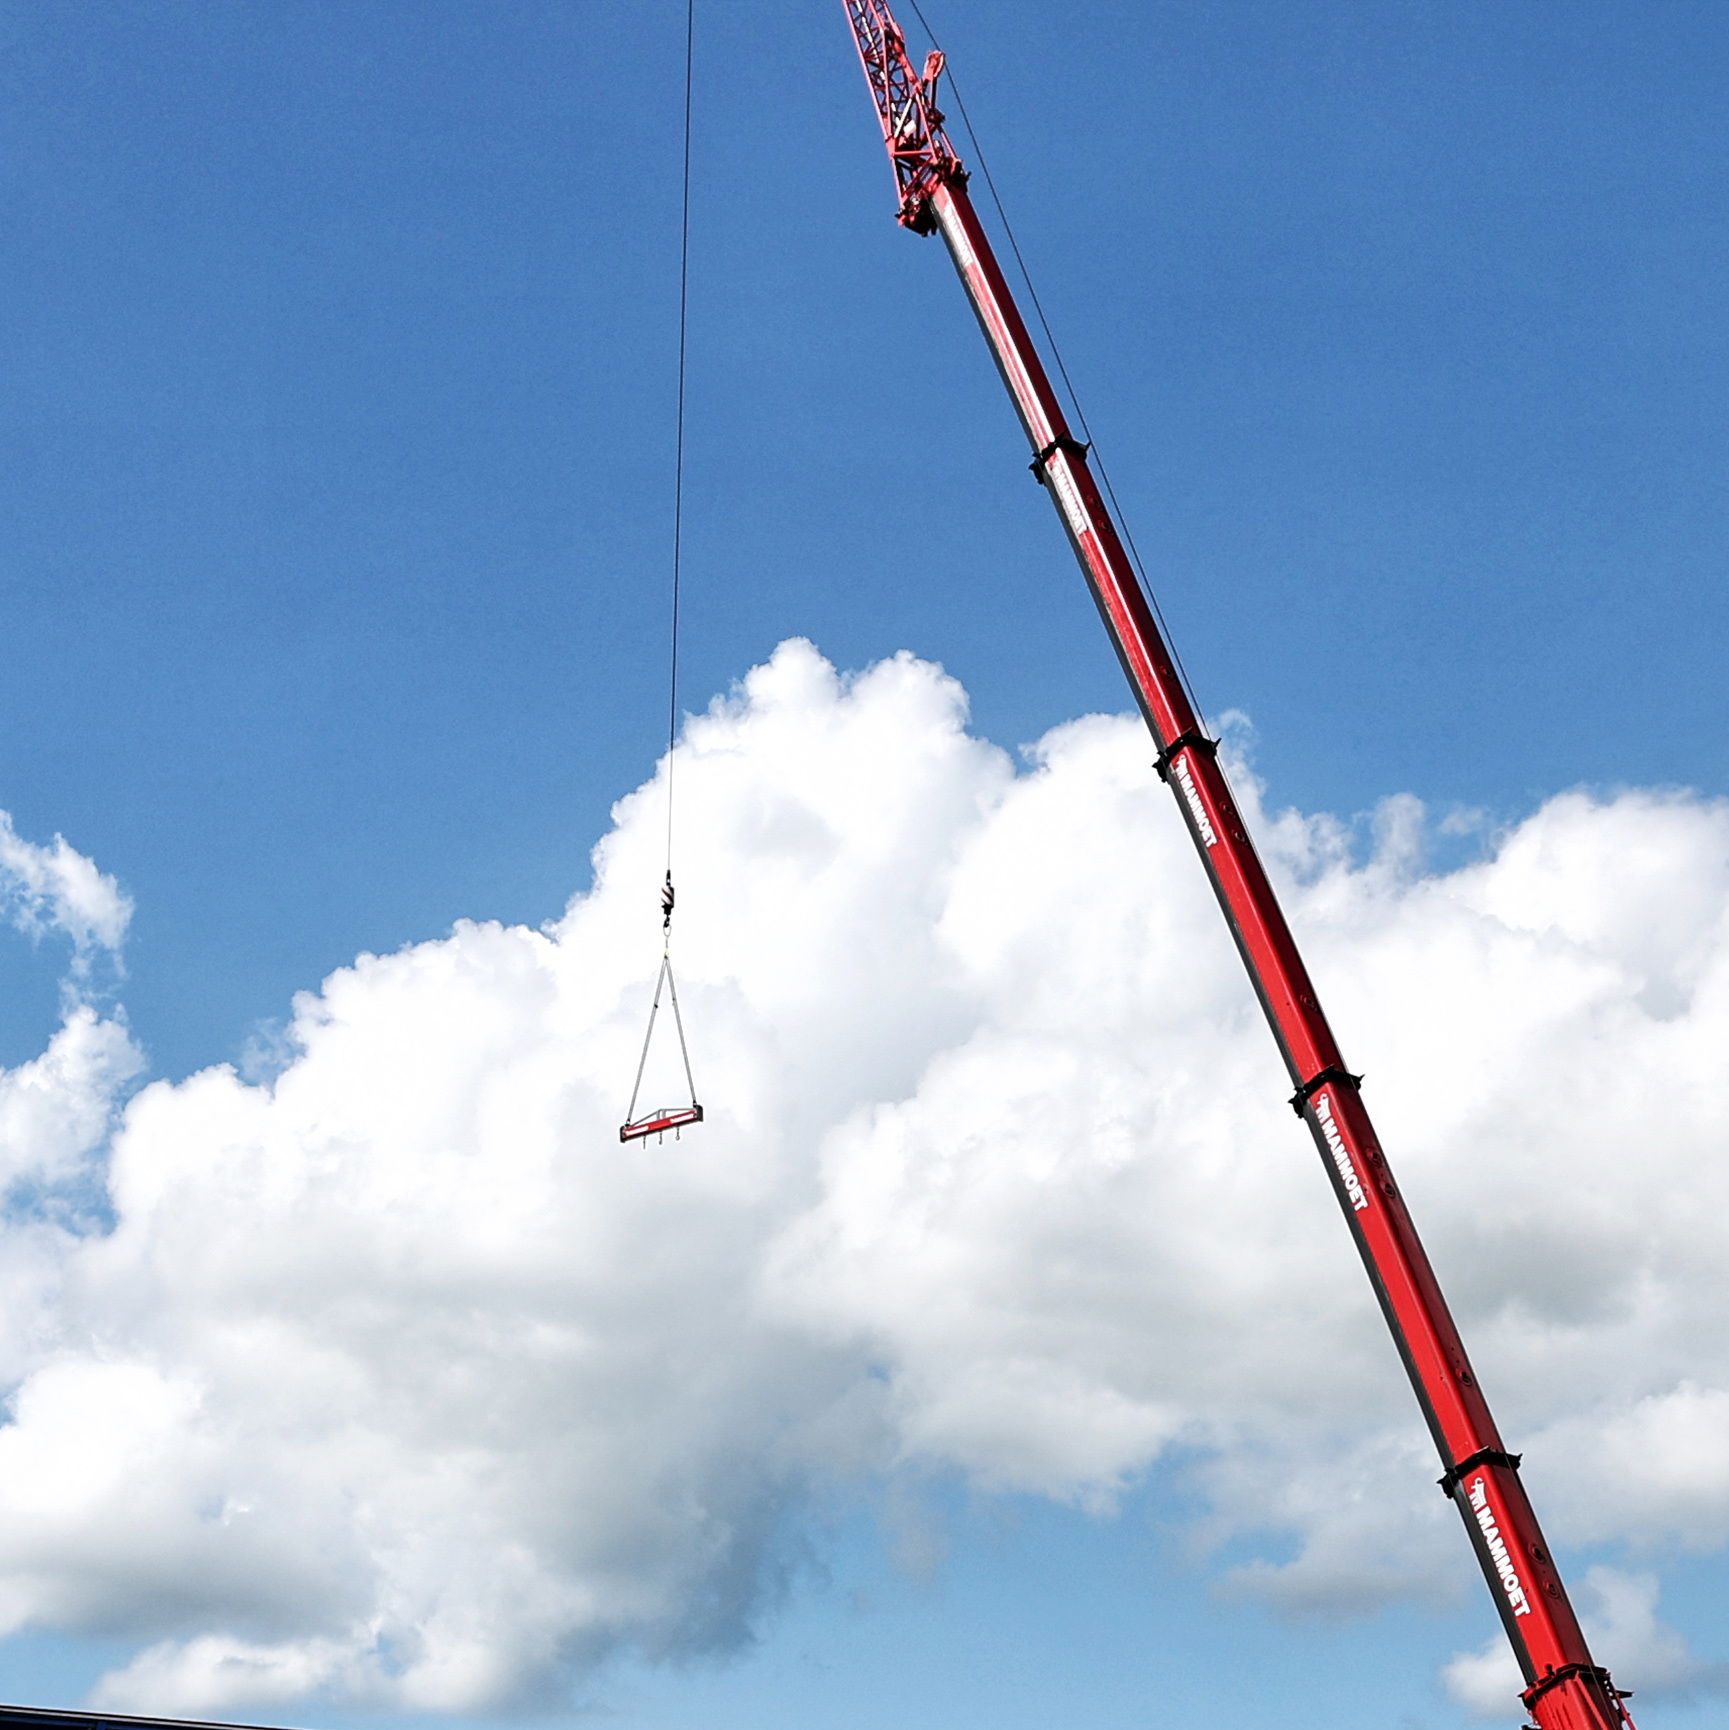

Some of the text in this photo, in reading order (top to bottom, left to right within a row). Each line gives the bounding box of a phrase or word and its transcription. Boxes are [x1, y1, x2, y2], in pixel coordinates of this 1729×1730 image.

[1180, 768, 1217, 850] MAMMOET
[1322, 1116, 1368, 1212] MAMMOET
[1476, 1505, 1530, 1617] MAMMOET
